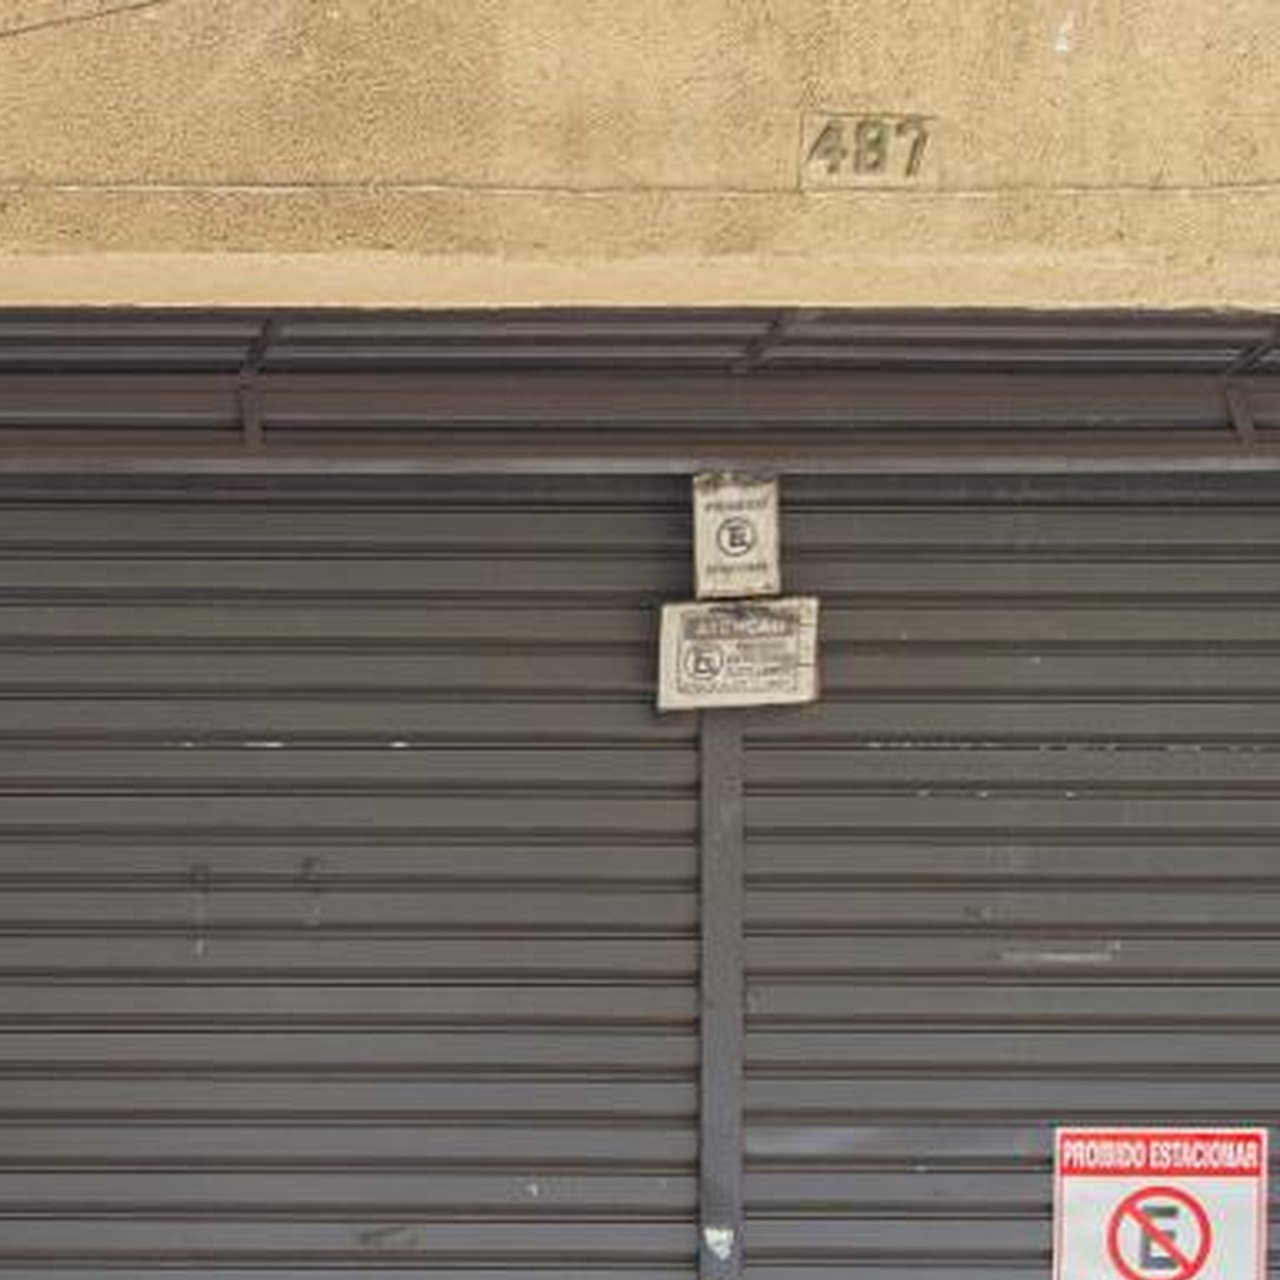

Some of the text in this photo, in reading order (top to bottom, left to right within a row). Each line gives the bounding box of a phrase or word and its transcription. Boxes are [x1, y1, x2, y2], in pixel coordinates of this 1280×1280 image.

[805, 117, 928, 177] 487
[1063, 1140, 1258, 1169] PROIBIDO ESTACIONAR
